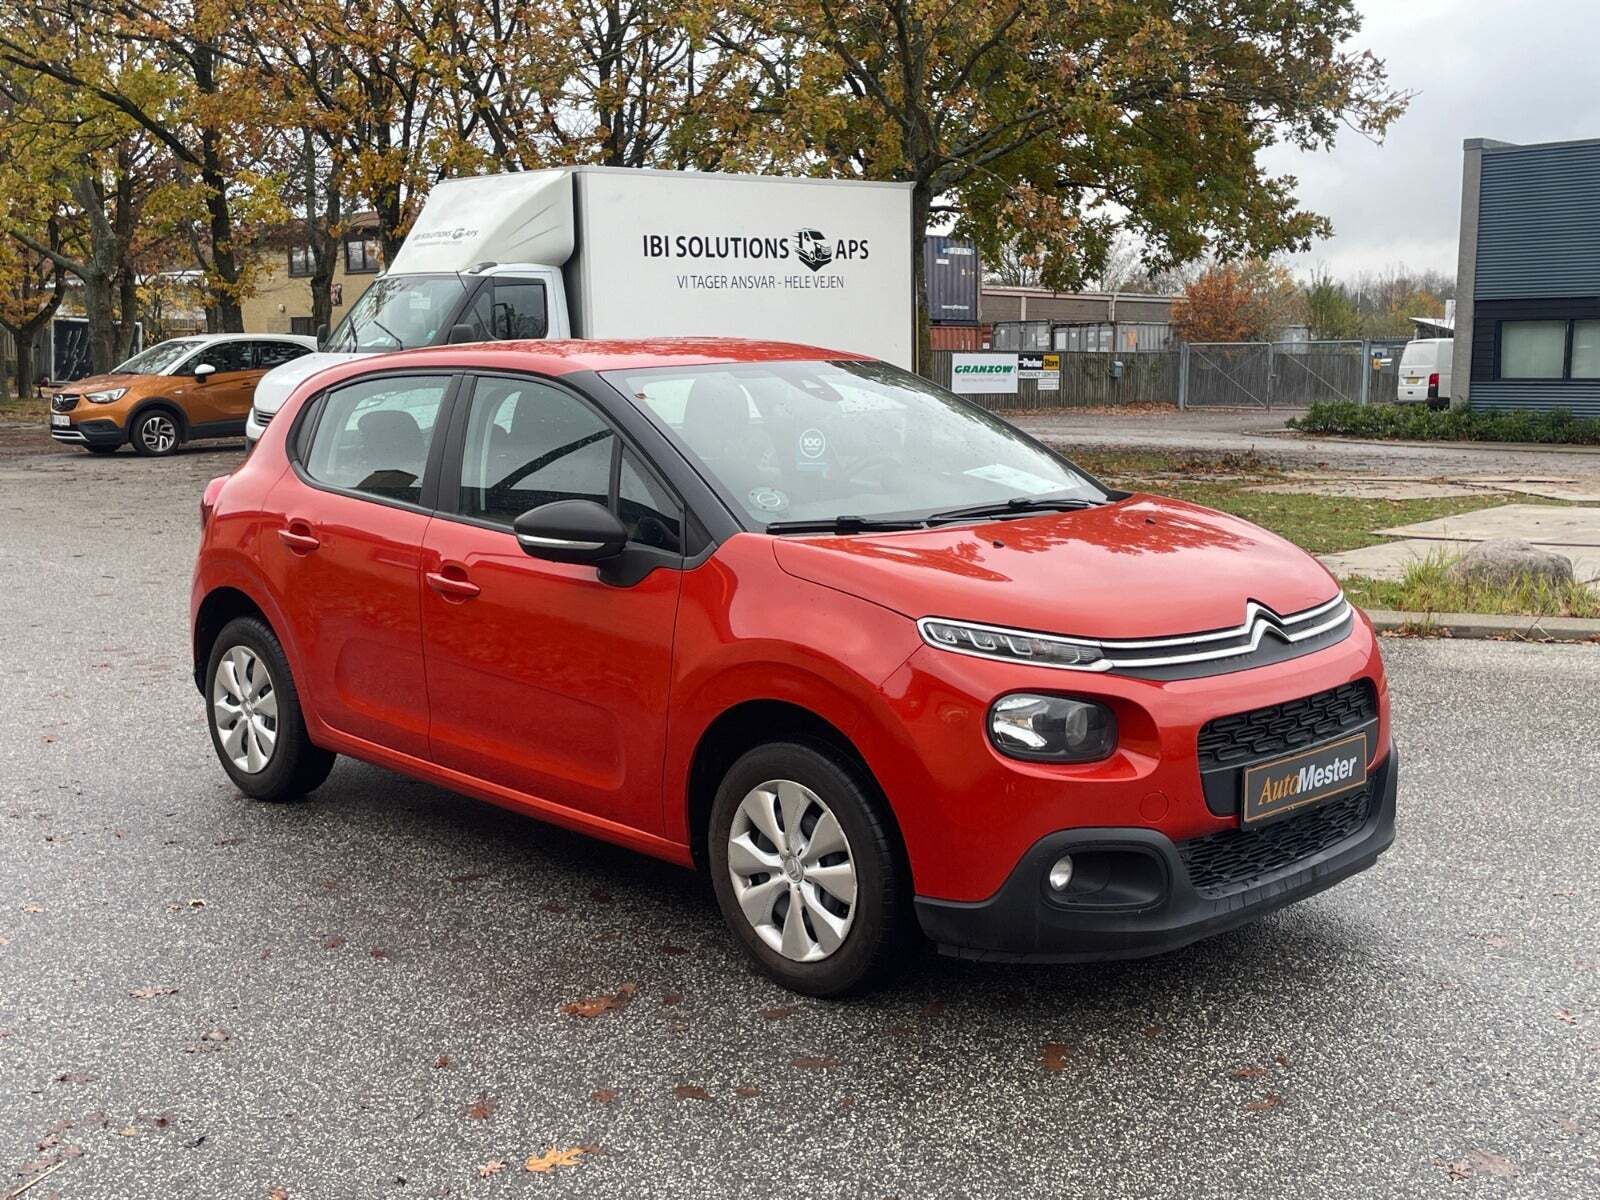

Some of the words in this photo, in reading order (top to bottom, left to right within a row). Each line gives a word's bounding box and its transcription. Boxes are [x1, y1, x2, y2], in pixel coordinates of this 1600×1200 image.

[643, 235, 669, 257] IBI
[676, 236, 789, 259] SOLUTIONS
[835, 240, 869, 259] APS
[677, 275, 688, 288] VI
[690, 275, 728, 288] TAGER
[730, 275, 775, 288] ANSVAR
[784, 275, 811, 288] HELE
[812, 275, 844, 288] VEJEN
[954, 365, 1013, 374] GRANZOW
[1258, 756, 1357, 805] AutoMester
